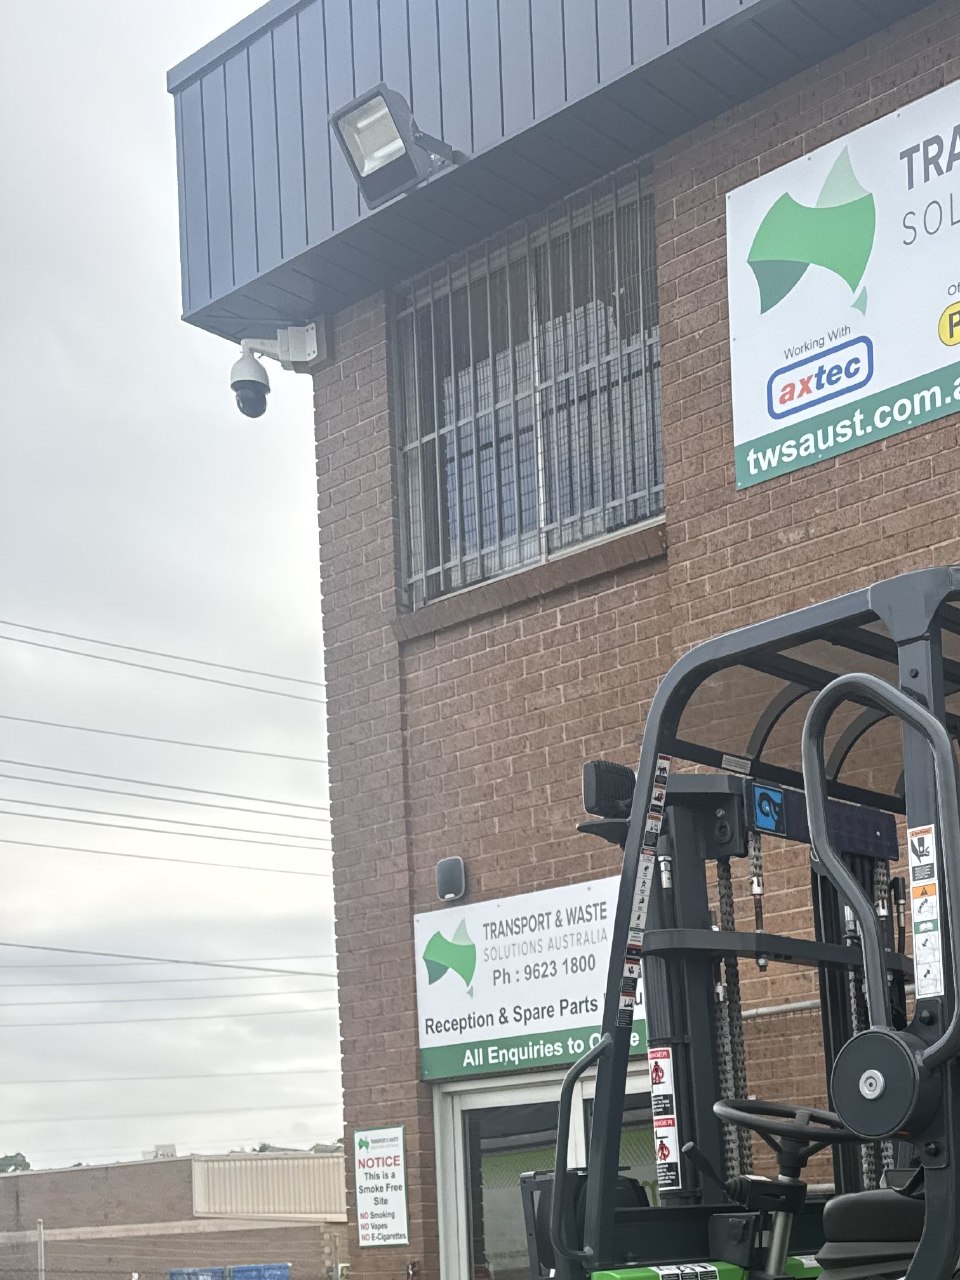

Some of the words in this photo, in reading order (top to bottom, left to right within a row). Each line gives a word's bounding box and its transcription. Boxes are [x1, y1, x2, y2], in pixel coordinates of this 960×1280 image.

[784, 334, 825, 360] Working
[828, 325, 851, 343] With
[779, 356, 861, 405] axtec
[483, 911, 551, 940] TRANSPORT
[555, 910, 563, 928] &
[566, 901, 607, 924] WASTE
[484, 938, 543, 962] SOLUTIONS
[547, 928, 608, 951] AUSTRALIA
[524, 962, 557, 981] 9623
[563, 954, 596, 975] 1800
[425, 1012, 494, 1035] Reception
[499, 1007, 509, 1025] &
[513, 1004, 555, 1026] Spare
[559, 996, 598, 1016] Parts
[463, 1049, 484, 1067] All
[488, 1040, 563, 1066] Enquiries
[568, 1037, 584, 1054] to
[359, 1156, 400, 1169] NOTICE
[364, 1172, 380, 1180] This
[383, 1171, 389, 1179] is
[359, 1184, 384, 1194] Smoke
[386, 1183, 403, 1192] Free
[374, 1197, 388, 1206] Site
[370, 1211, 396, 1220] Smoking
[371, 1222, 388, 1231] Vapes
